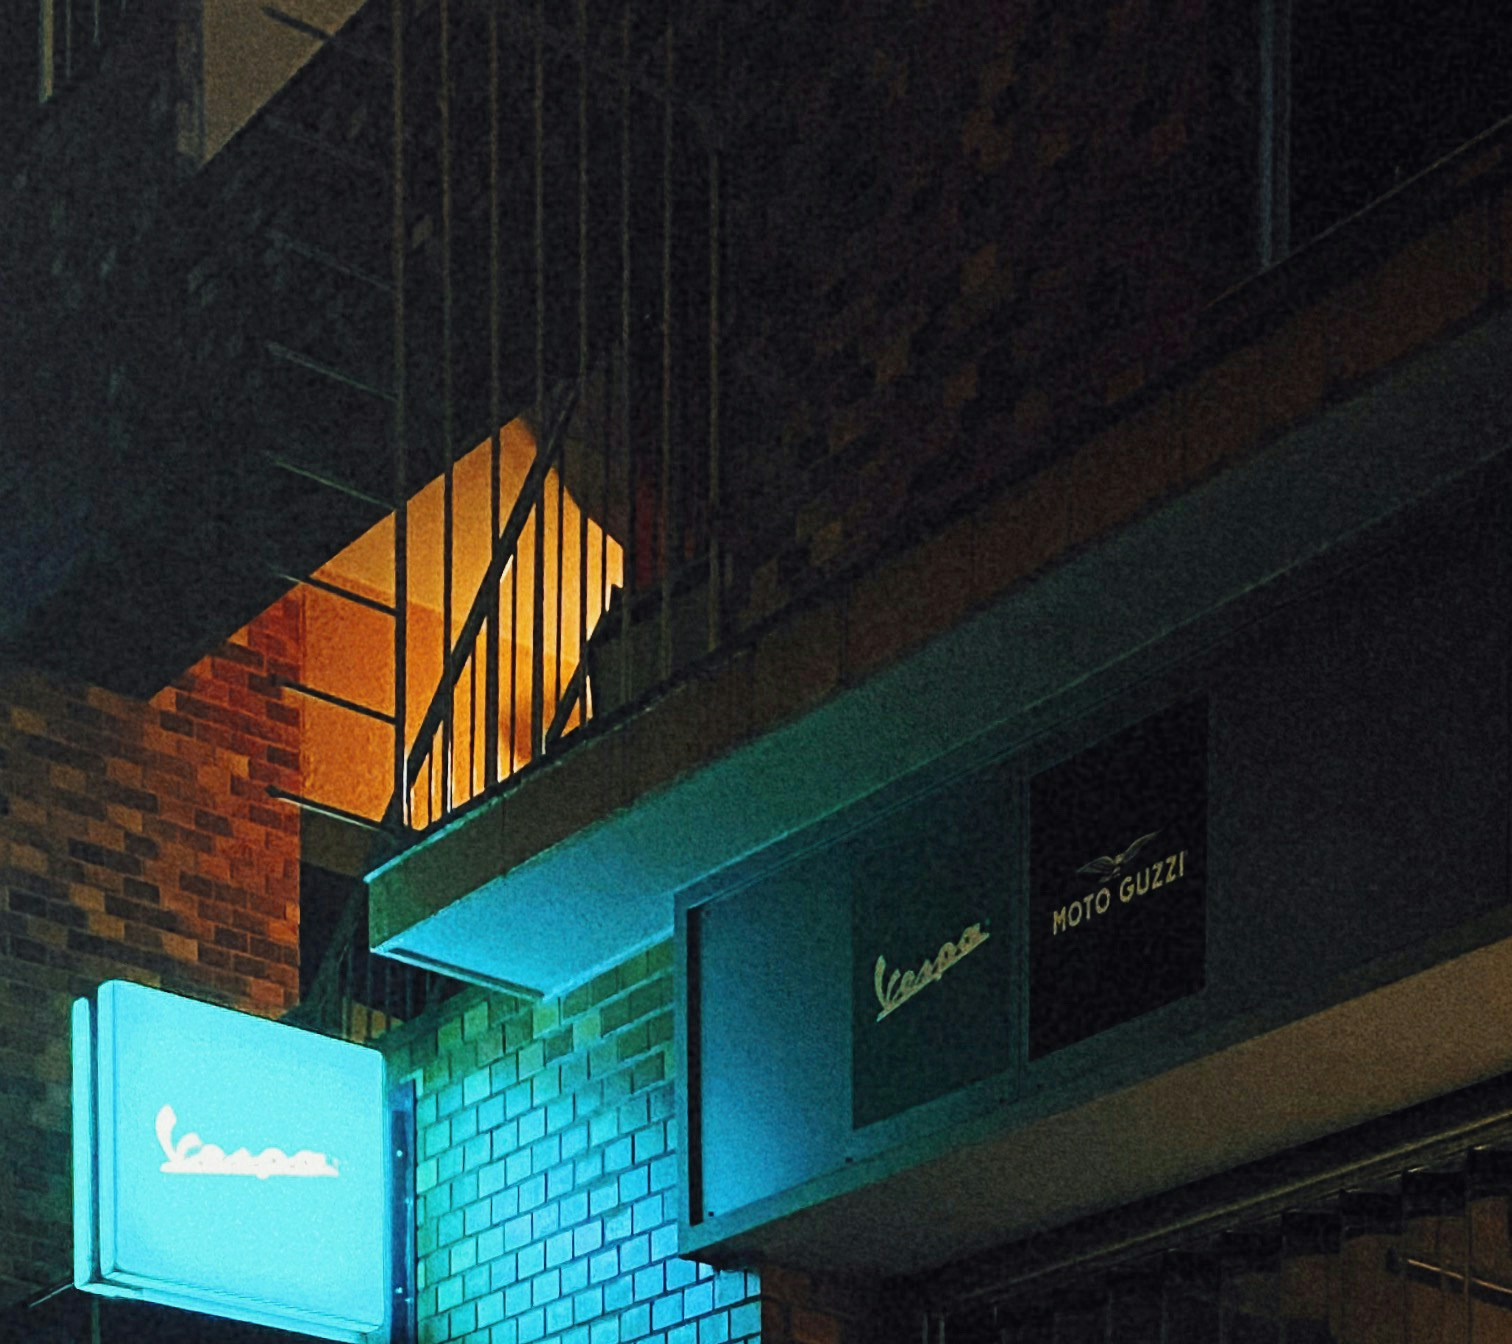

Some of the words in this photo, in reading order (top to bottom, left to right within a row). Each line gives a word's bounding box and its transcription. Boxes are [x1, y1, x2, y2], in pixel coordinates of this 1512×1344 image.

[1053, 887, 1111, 936] MOTO
[1119, 850, 1186, 904] GUZZI
[875, 921, 990, 1022] Vespa
